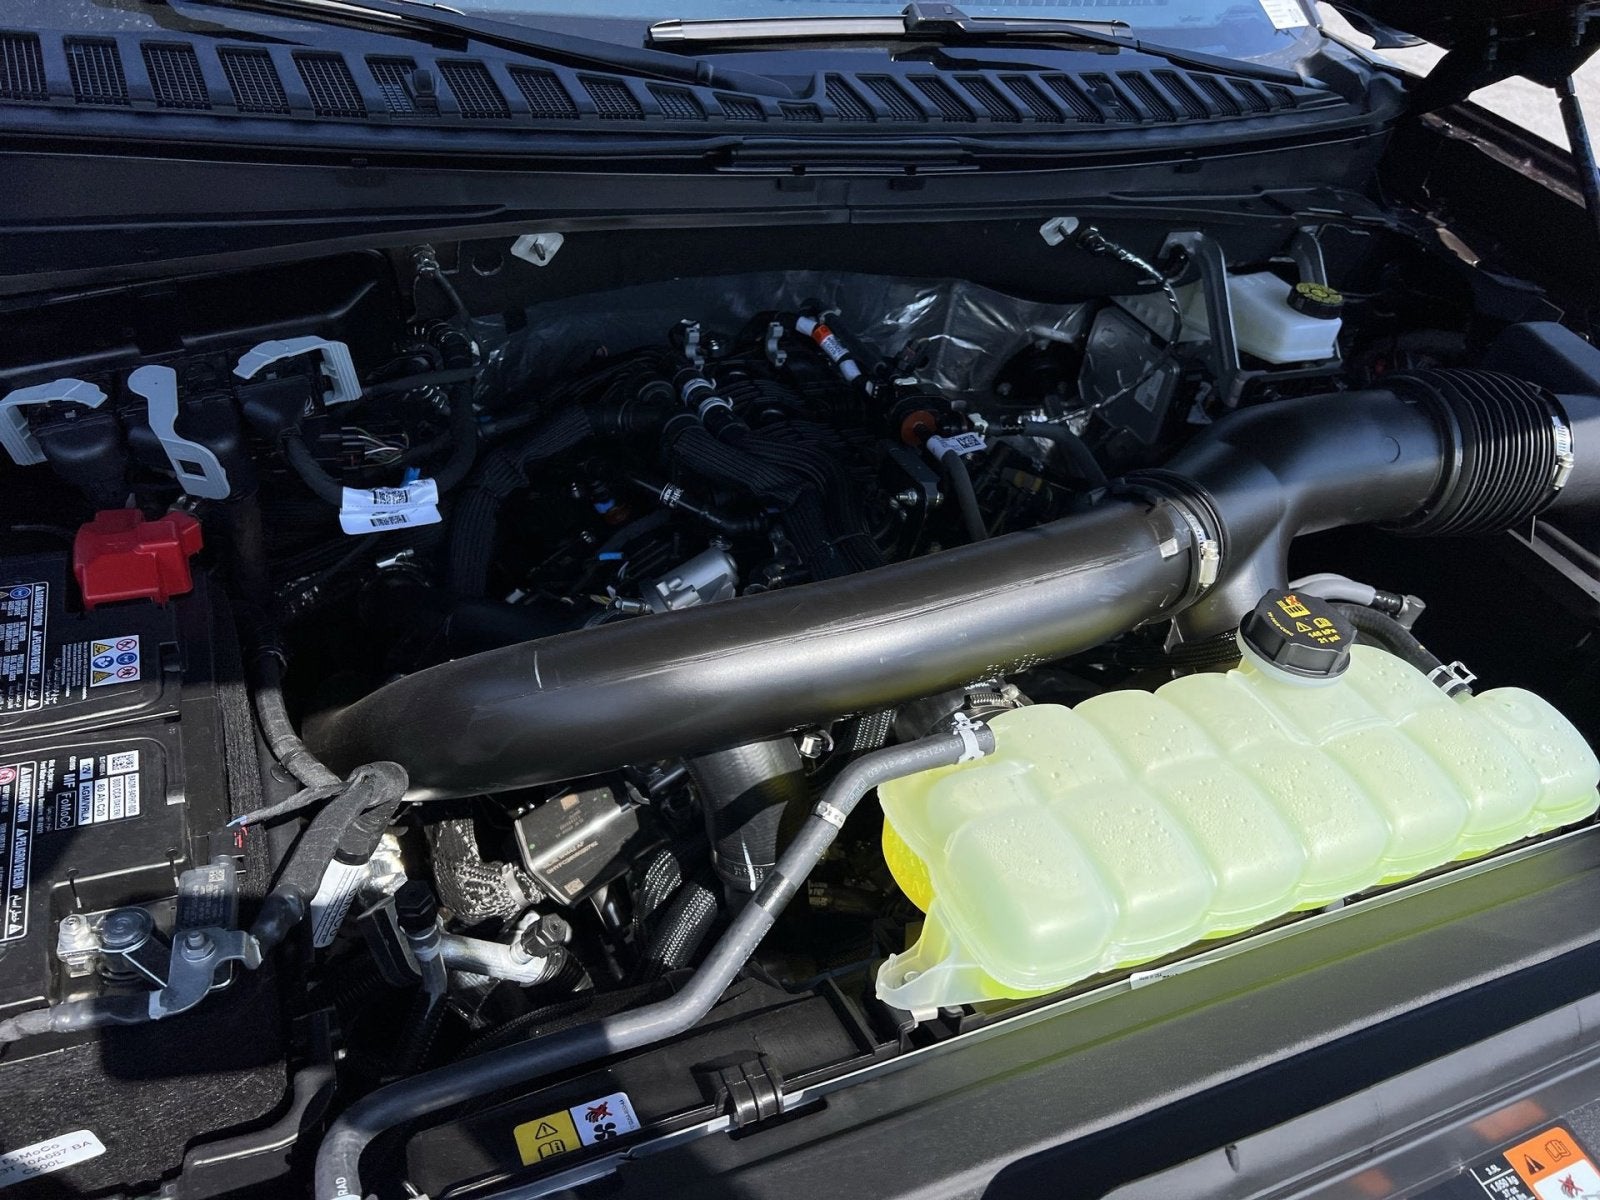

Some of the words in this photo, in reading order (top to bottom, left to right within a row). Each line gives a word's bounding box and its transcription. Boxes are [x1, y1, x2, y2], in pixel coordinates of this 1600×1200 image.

[82, 763, 91, 774] 12V
[59, 793, 72, 828] FoMoCo
[2, 1144, 60, 1165] FoMoCo
[71, 1141, 92, 1151] BA
[335, 1177, 349, 1196] RAD
